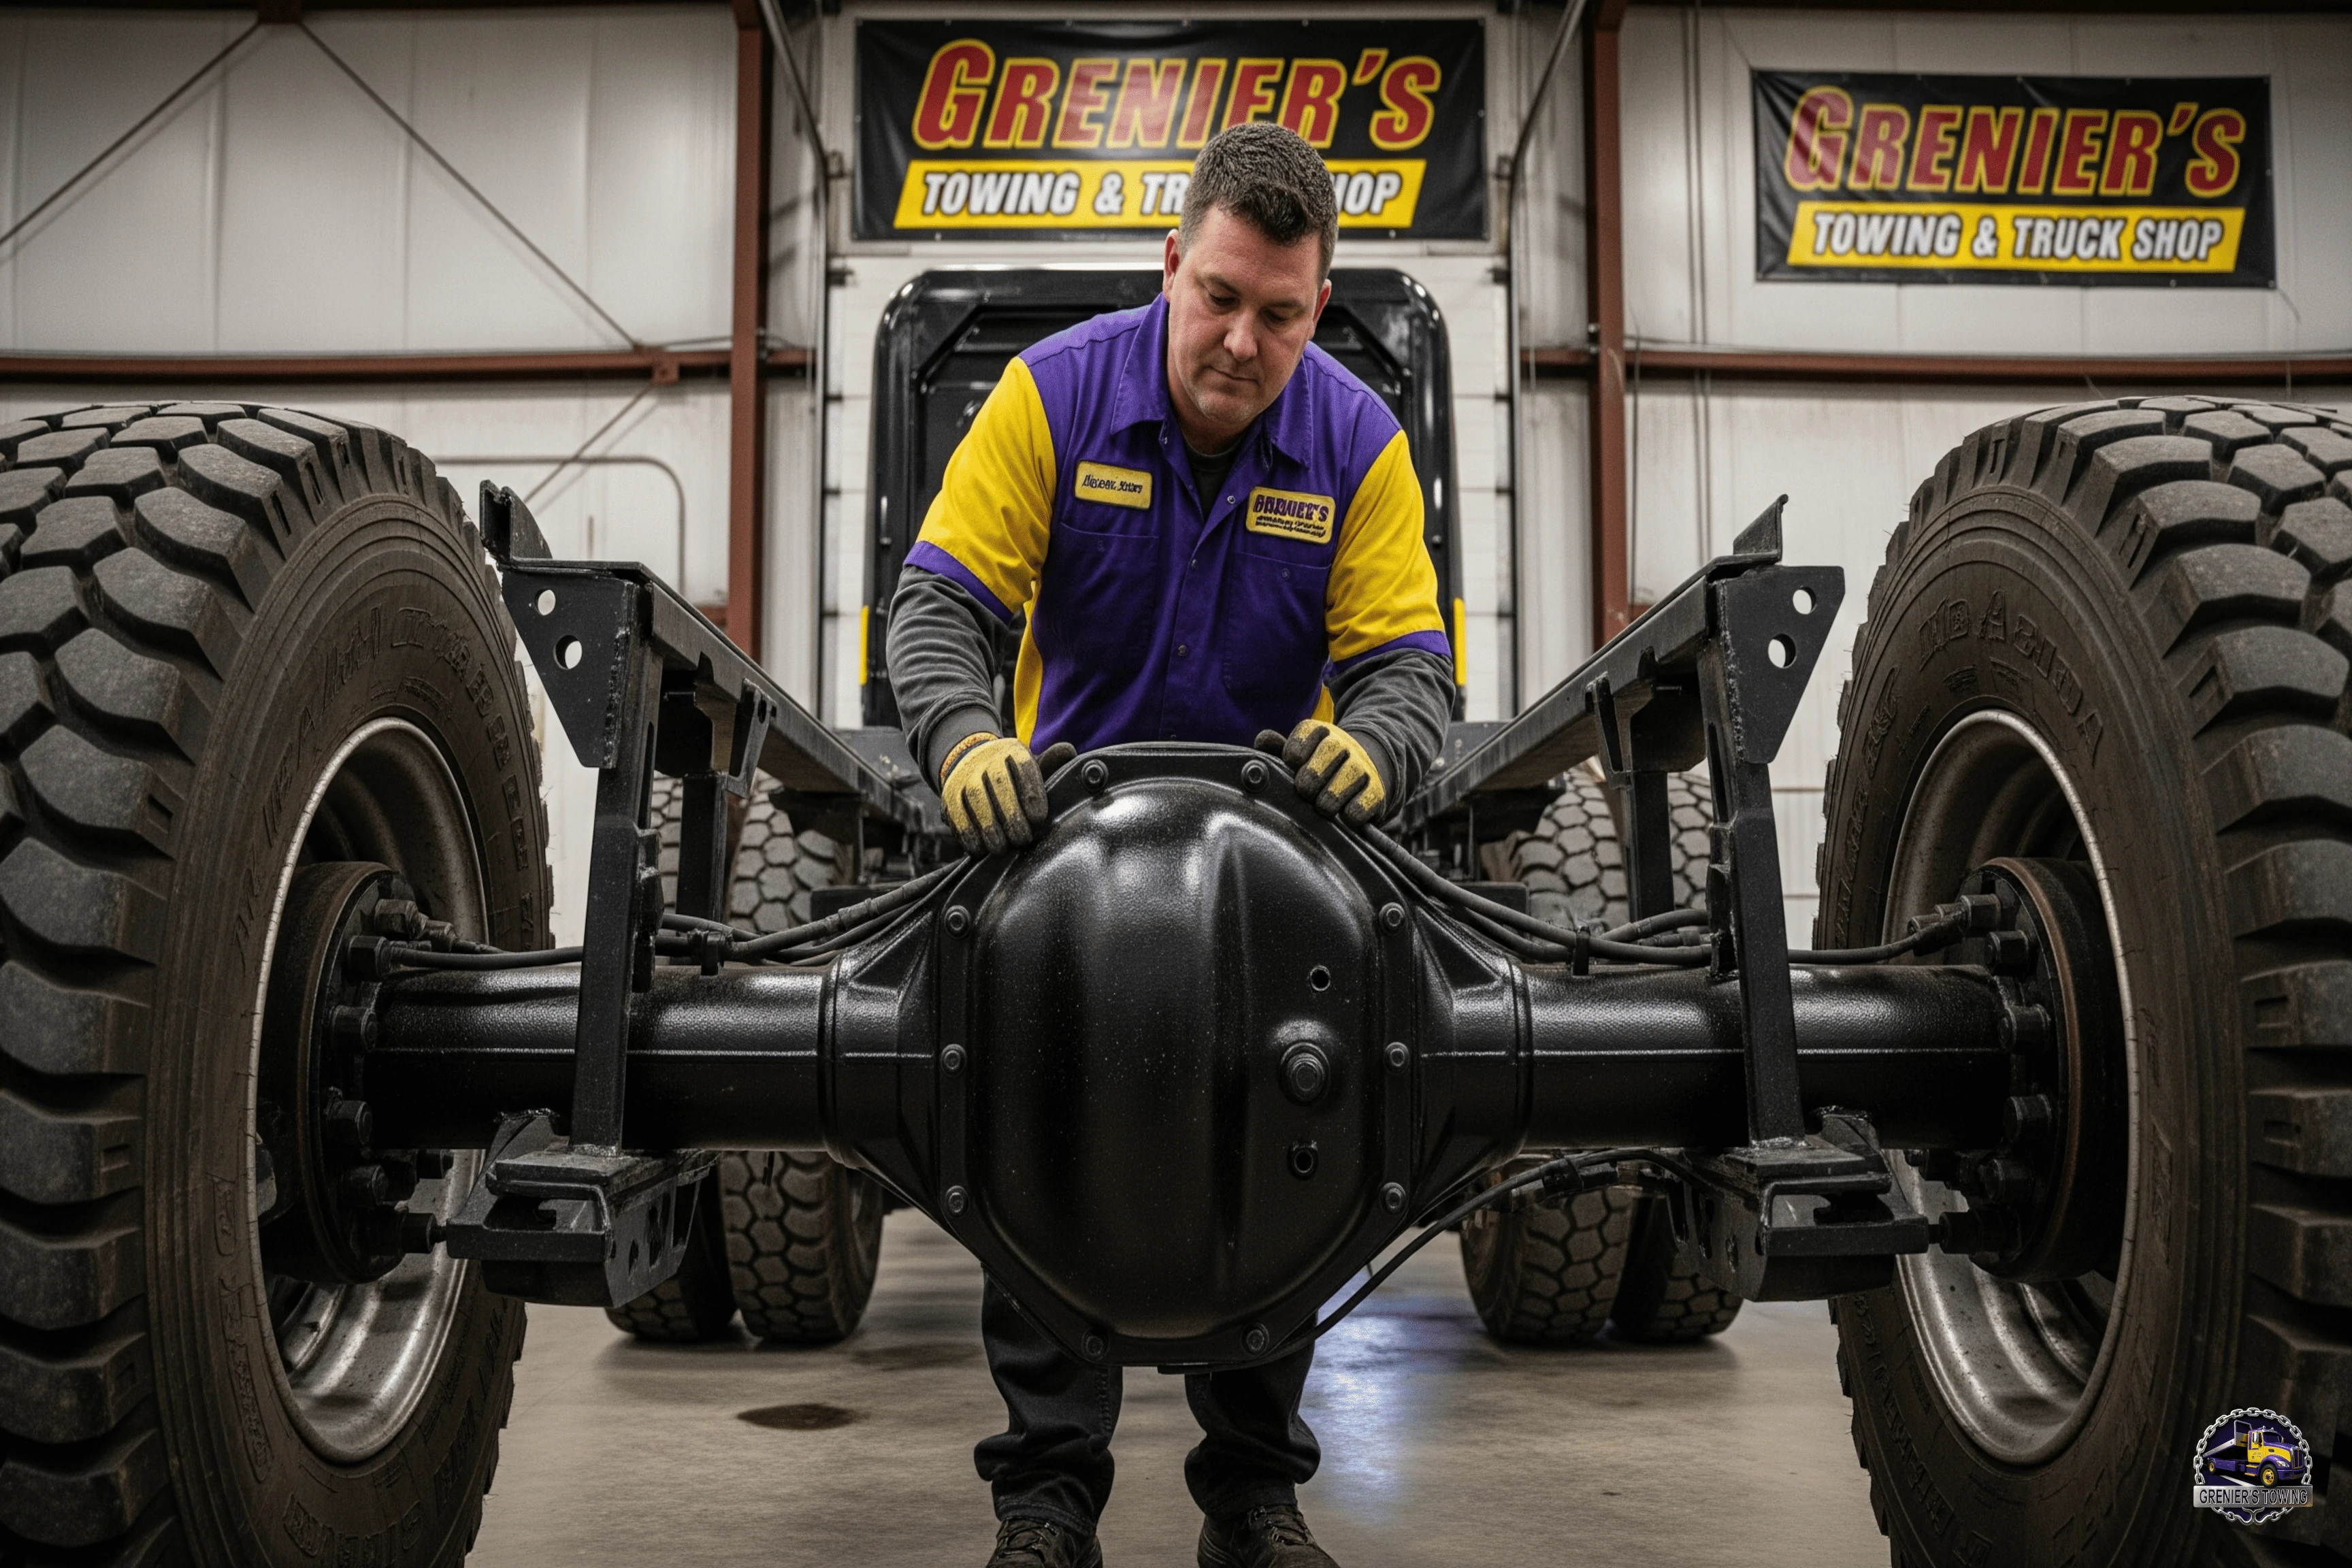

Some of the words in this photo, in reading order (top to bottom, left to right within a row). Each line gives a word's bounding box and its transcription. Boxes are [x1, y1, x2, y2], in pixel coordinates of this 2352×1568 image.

[912, 37, 1442, 151] GRENIER'S
[1785, 86, 2245, 197] GRENIER'S
[922, 171, 1080, 215] TOWING
[1093, 172, 1126, 215] &
[1329, 172, 1402, 215] OP
[1812, 212, 1961, 257] TOWING
[1972, 215, 1999, 258] &
[2012, 216, 2125, 261] TRUCK
[2132, 217, 2224, 262] SHOP
